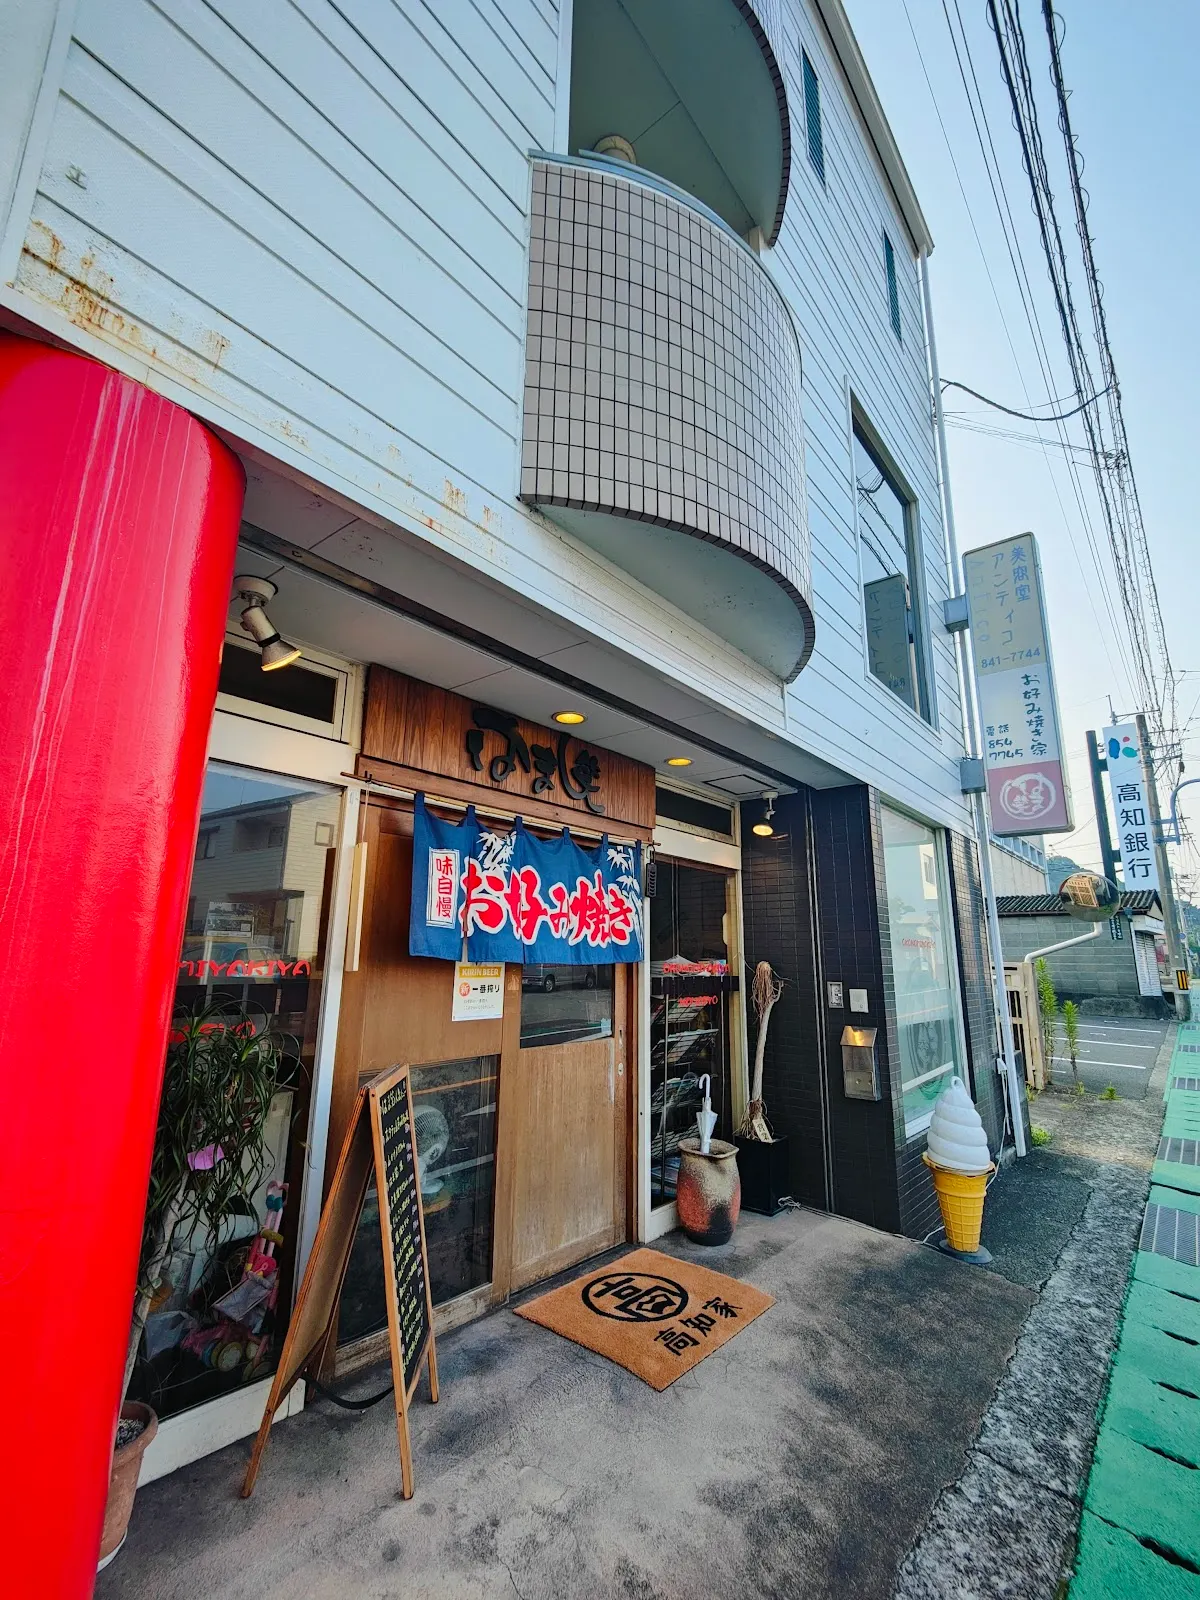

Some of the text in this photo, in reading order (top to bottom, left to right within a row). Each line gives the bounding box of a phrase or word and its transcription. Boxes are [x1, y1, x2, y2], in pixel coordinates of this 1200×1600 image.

[992, 552, 1014, 646] アンティコ
[981, 647, 1041, 669] 841-7744
[985, 723, 1010, 737] 電話
[988, 738, 1013, 749] 854
[989, 748, 1024, 761] 7745
[1116, 783, 1152, 879] 高知銀行
[435, 856, 454, 918] 味自慢
[462, 862, 635, 944] お好み焼き
[461, 968, 499, 976] KIRIN BEER
[653, 1296, 743, 1357] 高知家
